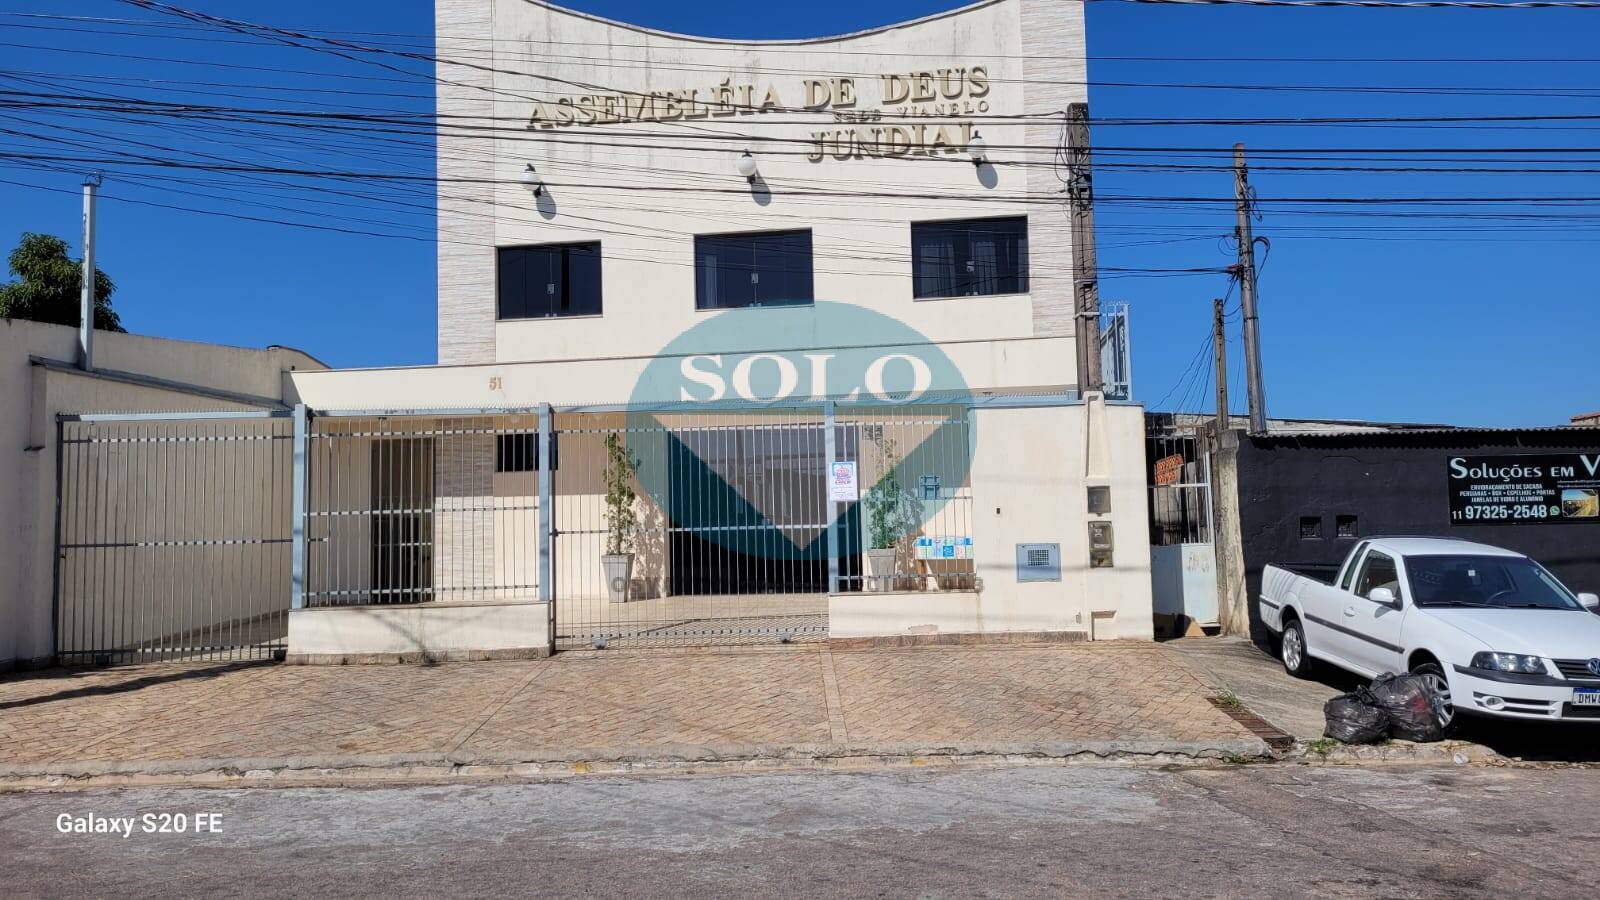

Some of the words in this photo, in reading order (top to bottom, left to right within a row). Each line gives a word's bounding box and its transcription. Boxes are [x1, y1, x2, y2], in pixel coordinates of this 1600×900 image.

[526, 77, 784, 130] ASSEMBLÉIA
[803, 78, 856, 110] DE
[881, 66, 990, 105] DEUS
[897, 101, 989, 117] VIANELO
[489, 376, 503, 391] 51
[1452, 511, 1462, 519] 11
[1465, 505, 1547, 519] 97325-2548
